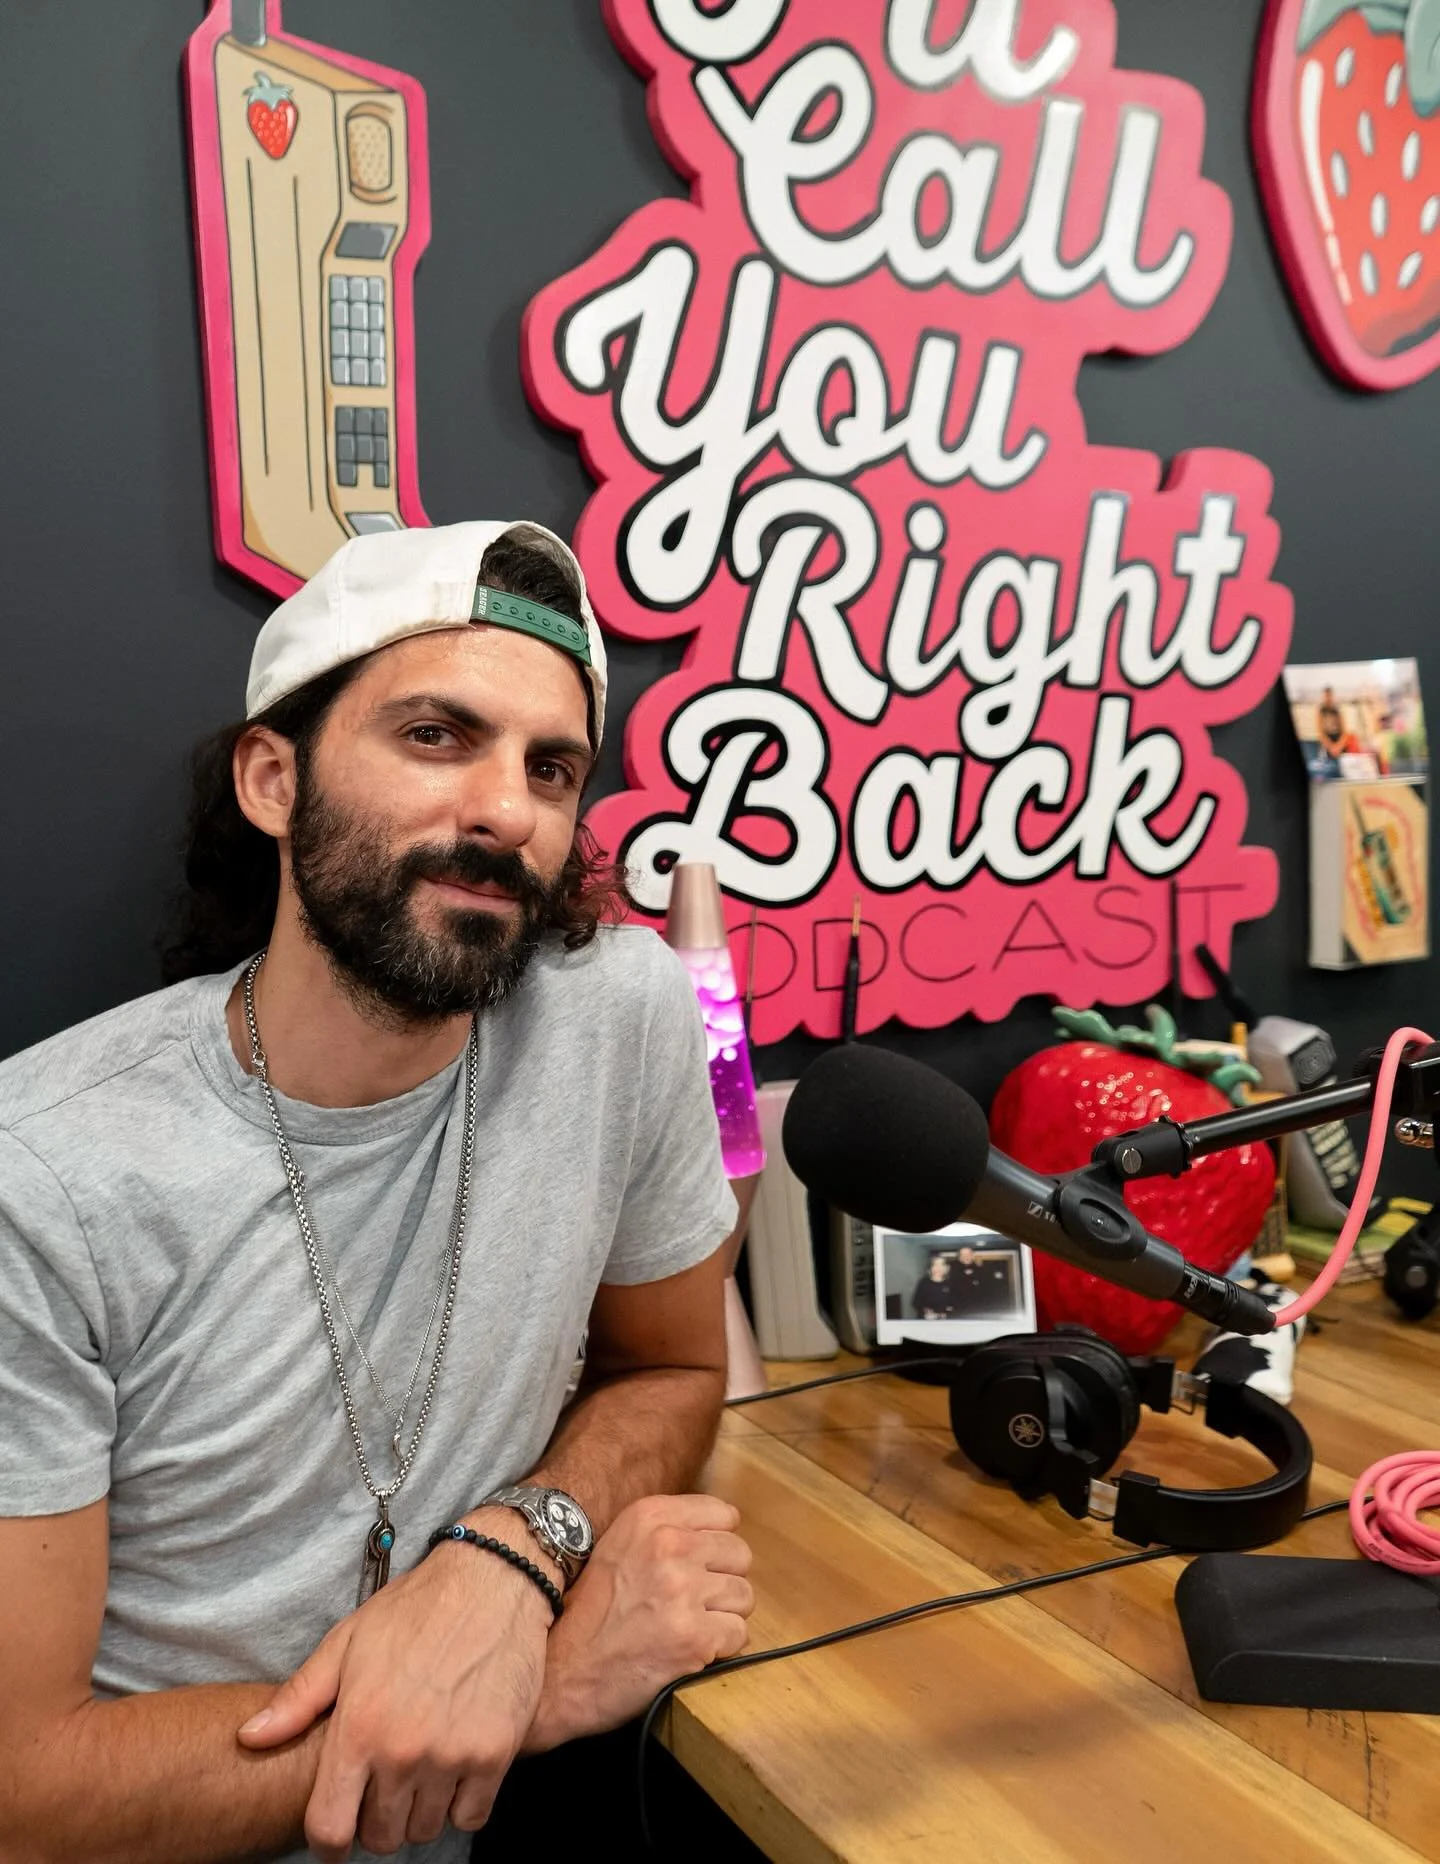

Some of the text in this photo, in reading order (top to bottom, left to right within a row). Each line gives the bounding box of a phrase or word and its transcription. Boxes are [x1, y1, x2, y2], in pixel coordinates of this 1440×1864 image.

[691, 40, 1195, 306] Call
[558, 237, 1049, 609] You
[725, 478, 1263, 760] Right
[624, 680, 1217, 910] Back
[726, 882, 1247, 1000] ODCAST
